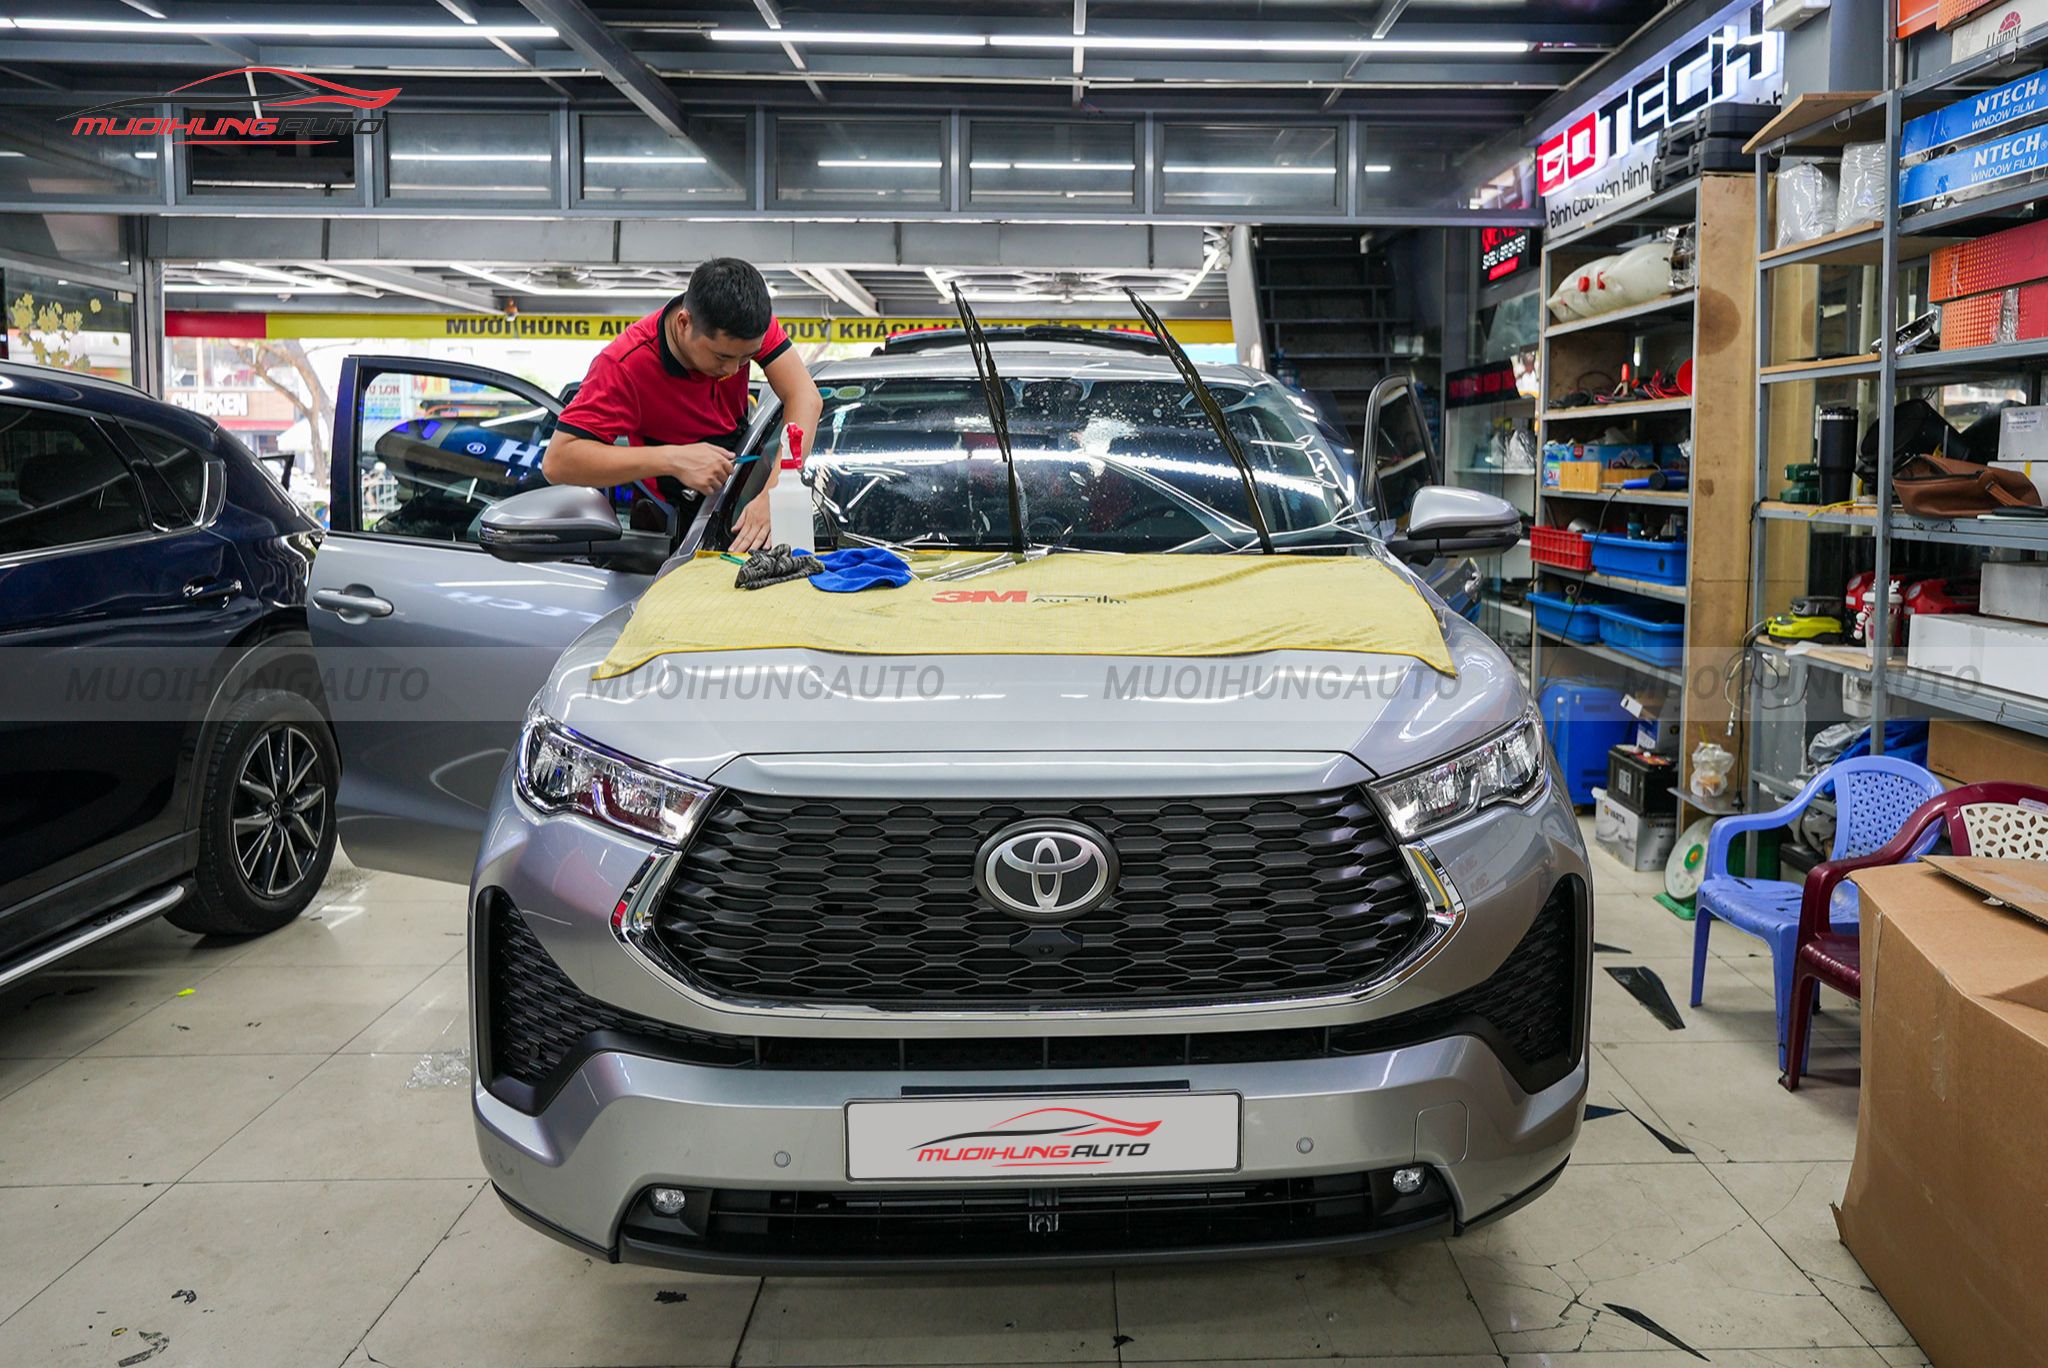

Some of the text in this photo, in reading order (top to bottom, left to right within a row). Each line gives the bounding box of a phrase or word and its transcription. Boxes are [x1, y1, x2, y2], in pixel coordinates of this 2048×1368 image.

[1974, 77, 2041, 117] NTECH
[1971, 99, 2036, 131] WINDOW FILM
[1973, 132, 2041, 169] NTECH
[1970, 153, 2038, 183] WINDOW FILM
[1572, 197, 1595, 217] Cao
[1621, 161, 1650, 193] Hình
[932, 590, 1029, 604] 3M
